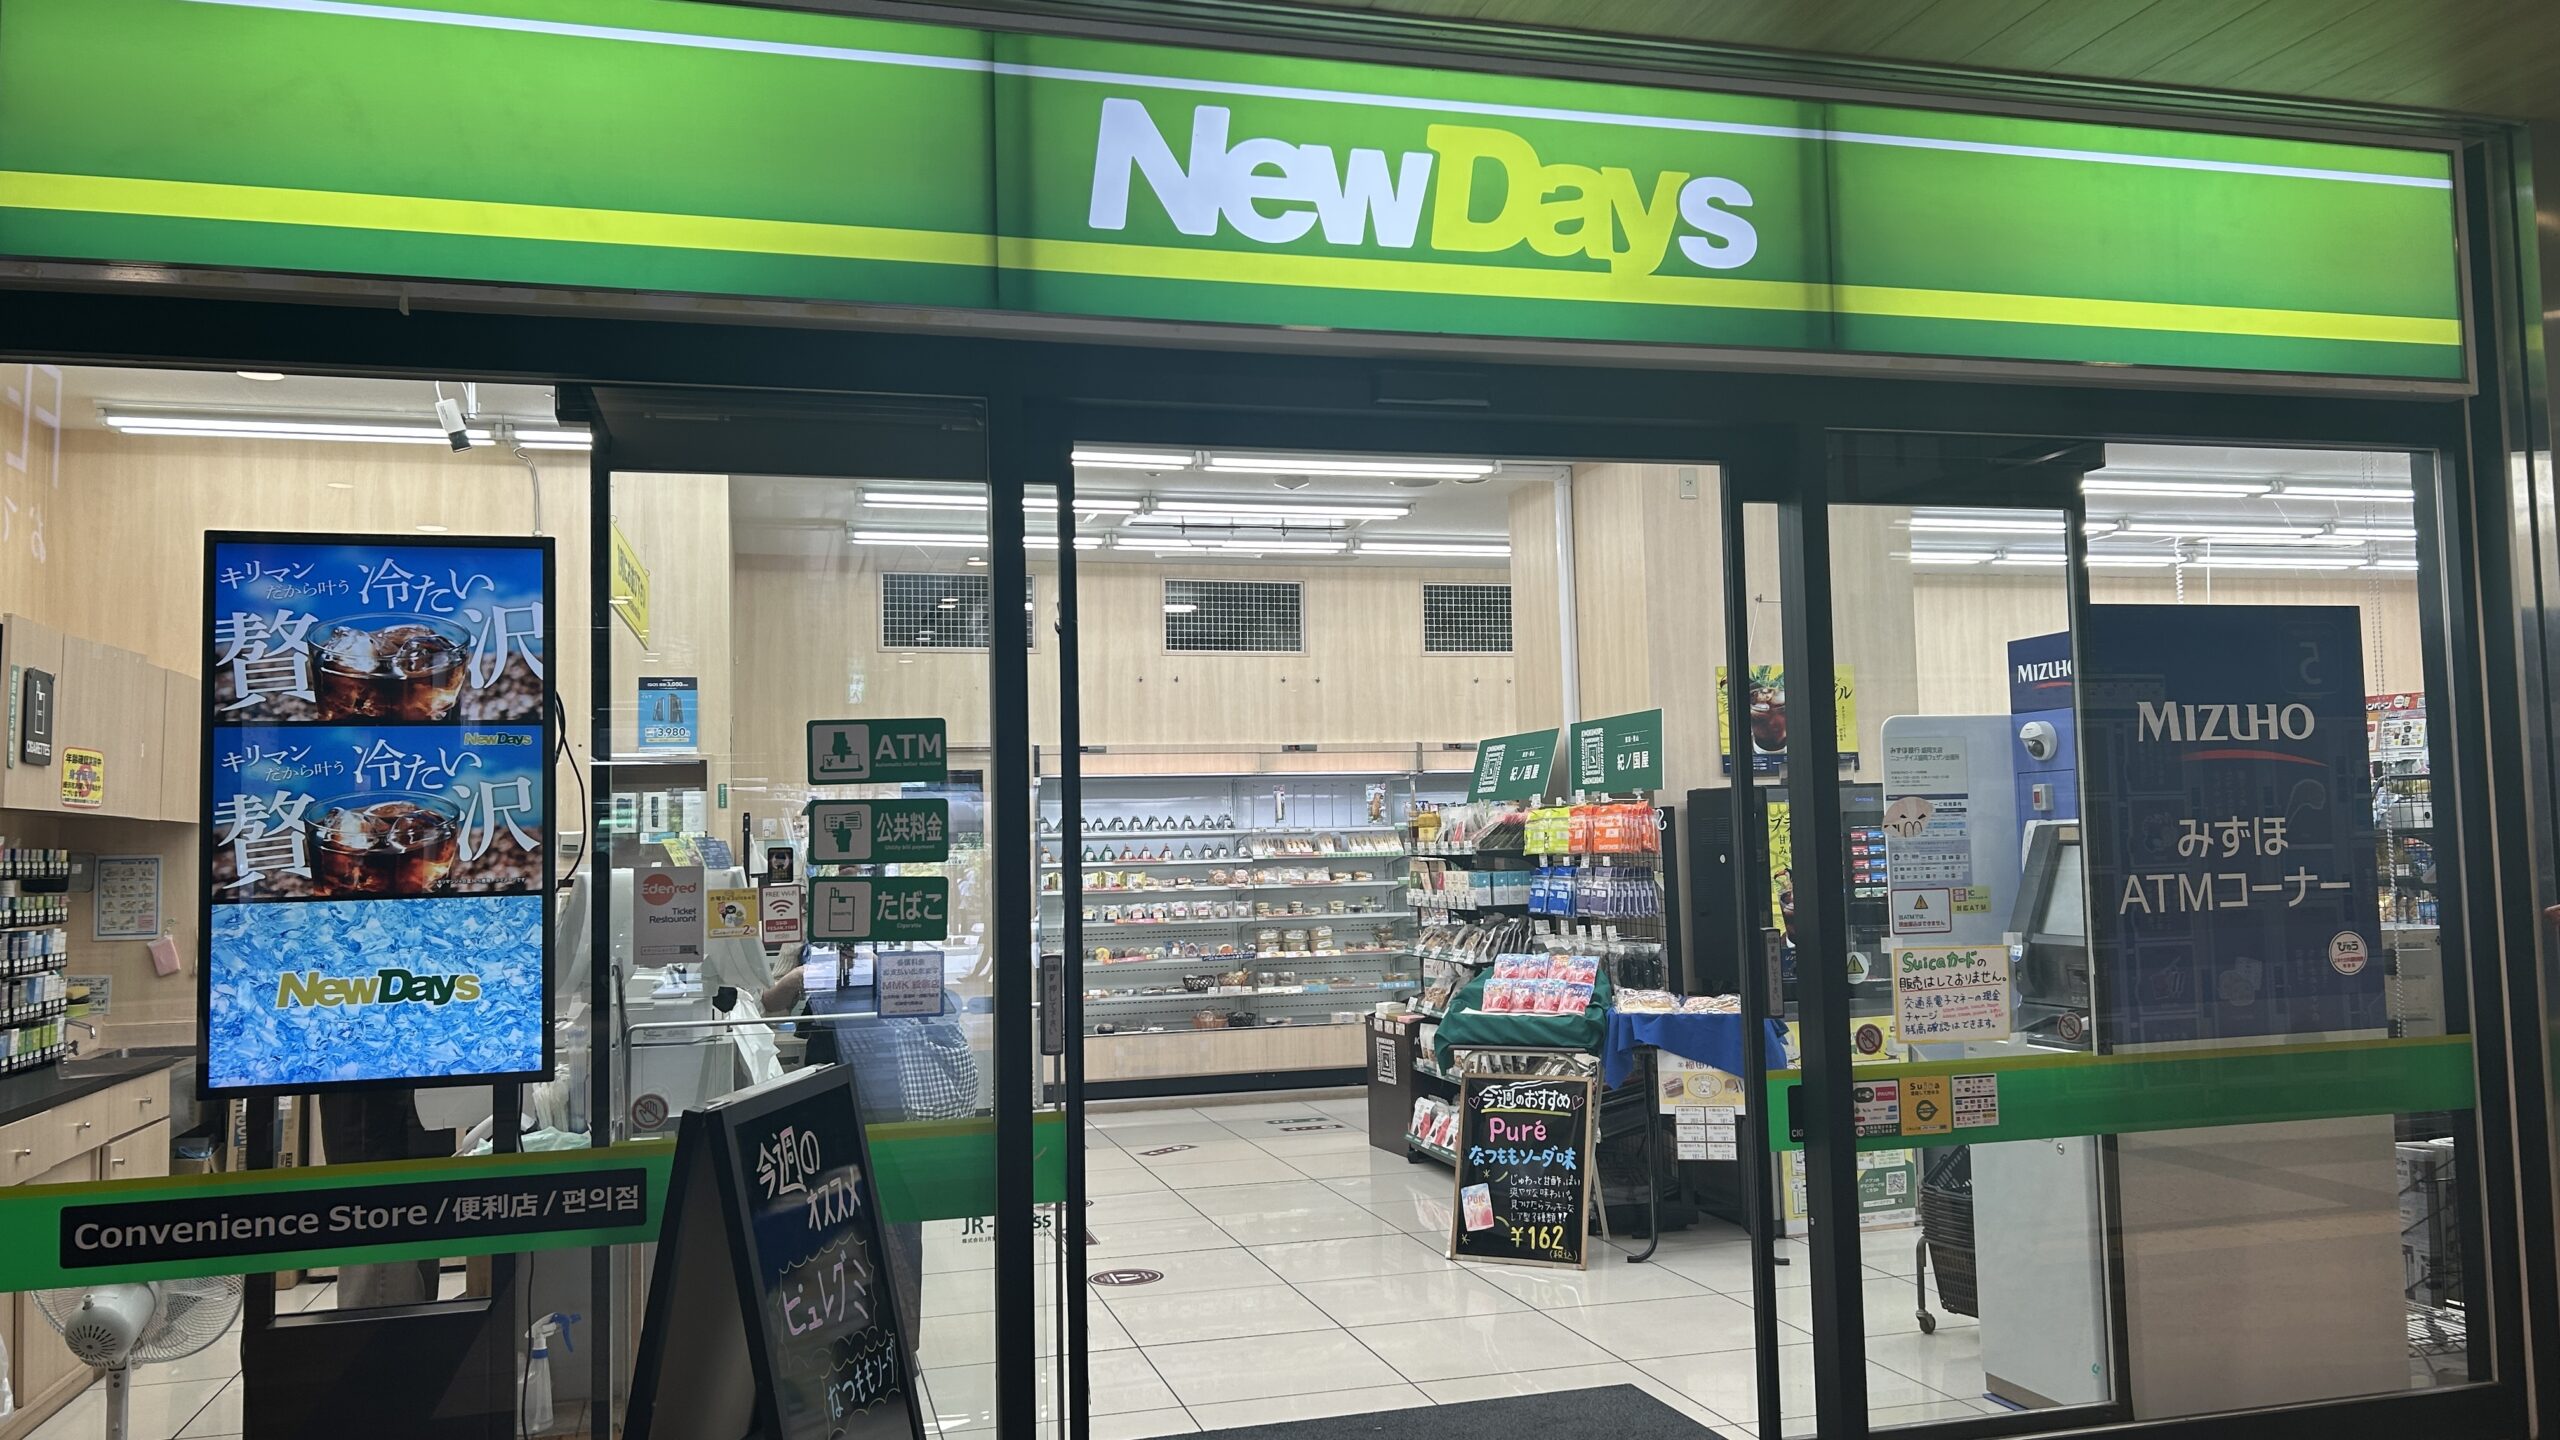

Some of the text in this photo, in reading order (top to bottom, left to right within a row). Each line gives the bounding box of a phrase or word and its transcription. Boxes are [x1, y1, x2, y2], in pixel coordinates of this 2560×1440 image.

[1089, 97, 1757, 276] NewDays
[219, 559, 316, 590] キリマン
[357, 557, 495, 613] 冷たい
[266, 579, 350, 600] だから叶う
[2136, 701, 2316, 742] MIZUHO
[463, 732, 532, 746] NewDays
[875, 733, 942, 760] ATM
[221, 744, 312, 774] キリマン
[265, 761, 345, 782] だから叶う
[352, 739, 482, 791] 冷たい
[1509, 763, 1540, 781] 紀ノ国屋
[1616, 751, 1649, 771] 紀ノ国屋
[877, 811, 943, 843] 公共料金
[2177, 815, 2289, 858] みずほ
[642, 882, 697, 895] Edenred
[2119, 867, 2351, 915] ATMコーナー
[671, 907, 697, 915] Ticket
[877, 889, 943, 921] たばこ
[649, 915, 697, 924] Restaurant
[2336, 941, 2359, 952] びゅう
[1902, 950, 1987, 973] Suicaカードの
[276, 968, 481, 1009] NewDays
[1899, 971, 2007, 990] 販売はしておりません。
[1904, 989, 2001, 1009] 交通系電子マネーの現金
[1904, 1010, 1938, 1022] チャージ
[1904, 1018, 1996, 1035] 残高確認はできます。
[1478, 1085, 1571, 1111] 今週のおすすめ
[1909, 1082, 1940, 1091] Suica
[1488, 1117, 1547, 1143] Puré
[756, 1125, 821, 1200] 今週の
[1468, 1145, 1577, 1171] なつももソーダ味
[806, 1167, 862, 1232] オススメ
[73, 1210, 320, 1251] Convenience
[328, 1203, 429, 1232] Store
[1510, 1225, 1564, 1250] ¥162
